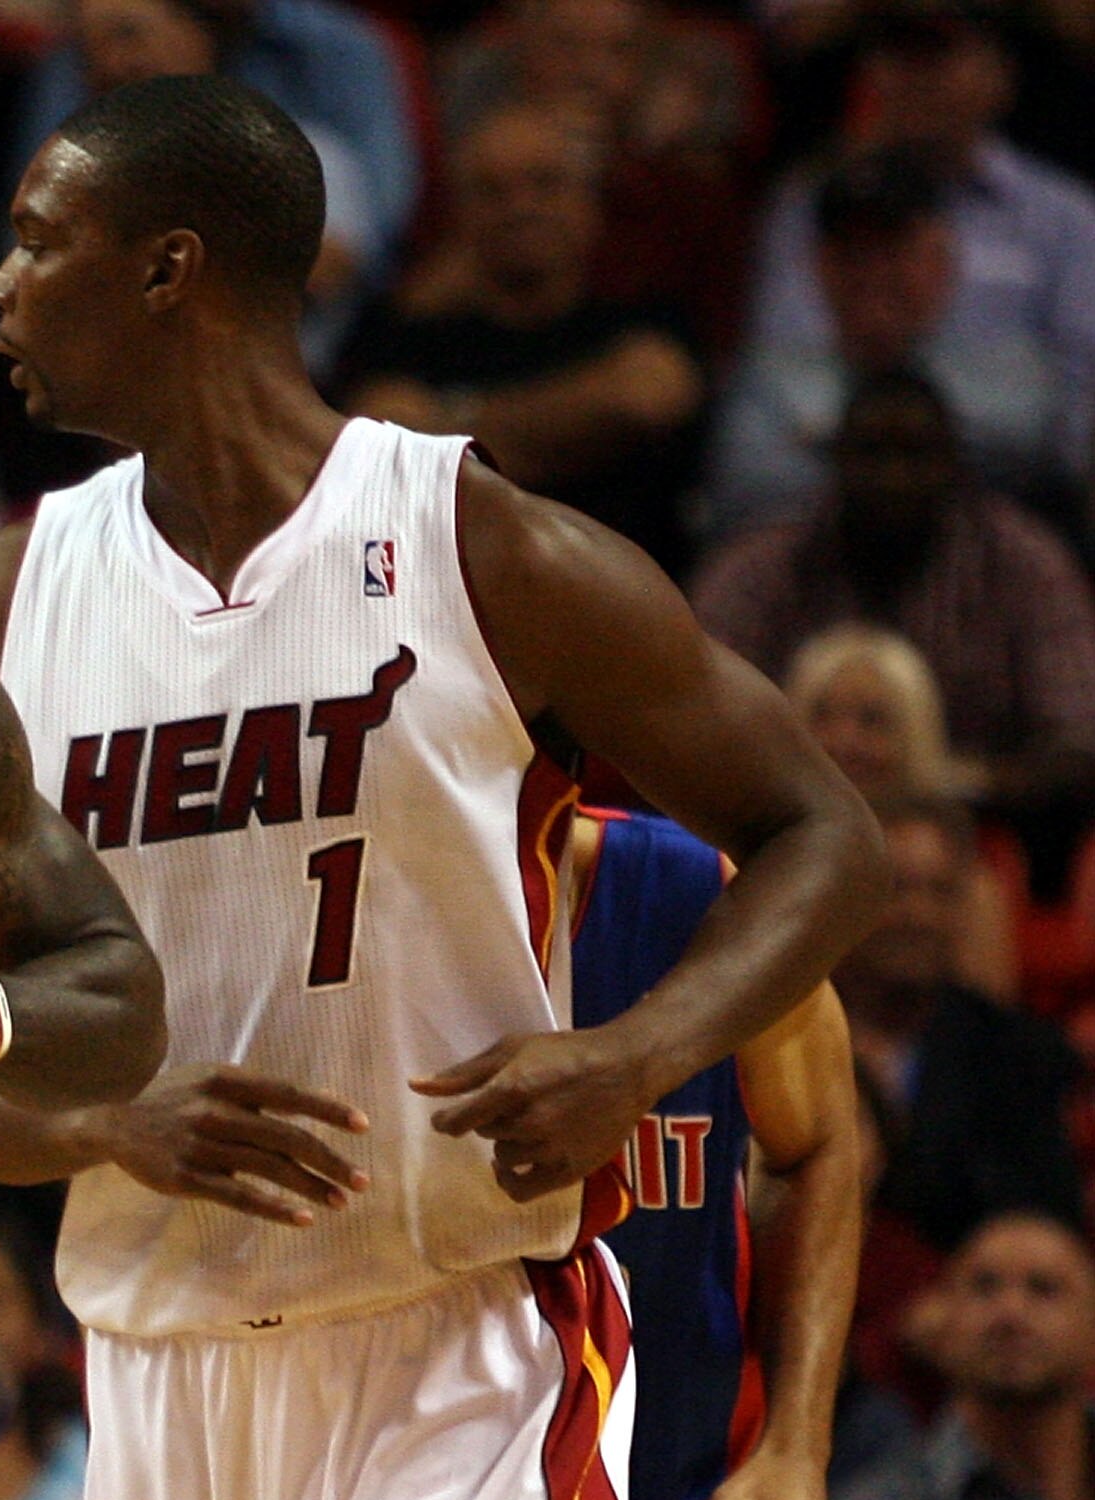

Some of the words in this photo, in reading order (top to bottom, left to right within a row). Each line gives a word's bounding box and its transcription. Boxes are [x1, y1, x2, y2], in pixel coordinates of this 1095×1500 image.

[60, 643, 418, 851] HEAT
[306, 836, 367, 988] 1
[620, 1114, 713, 1209] IT
